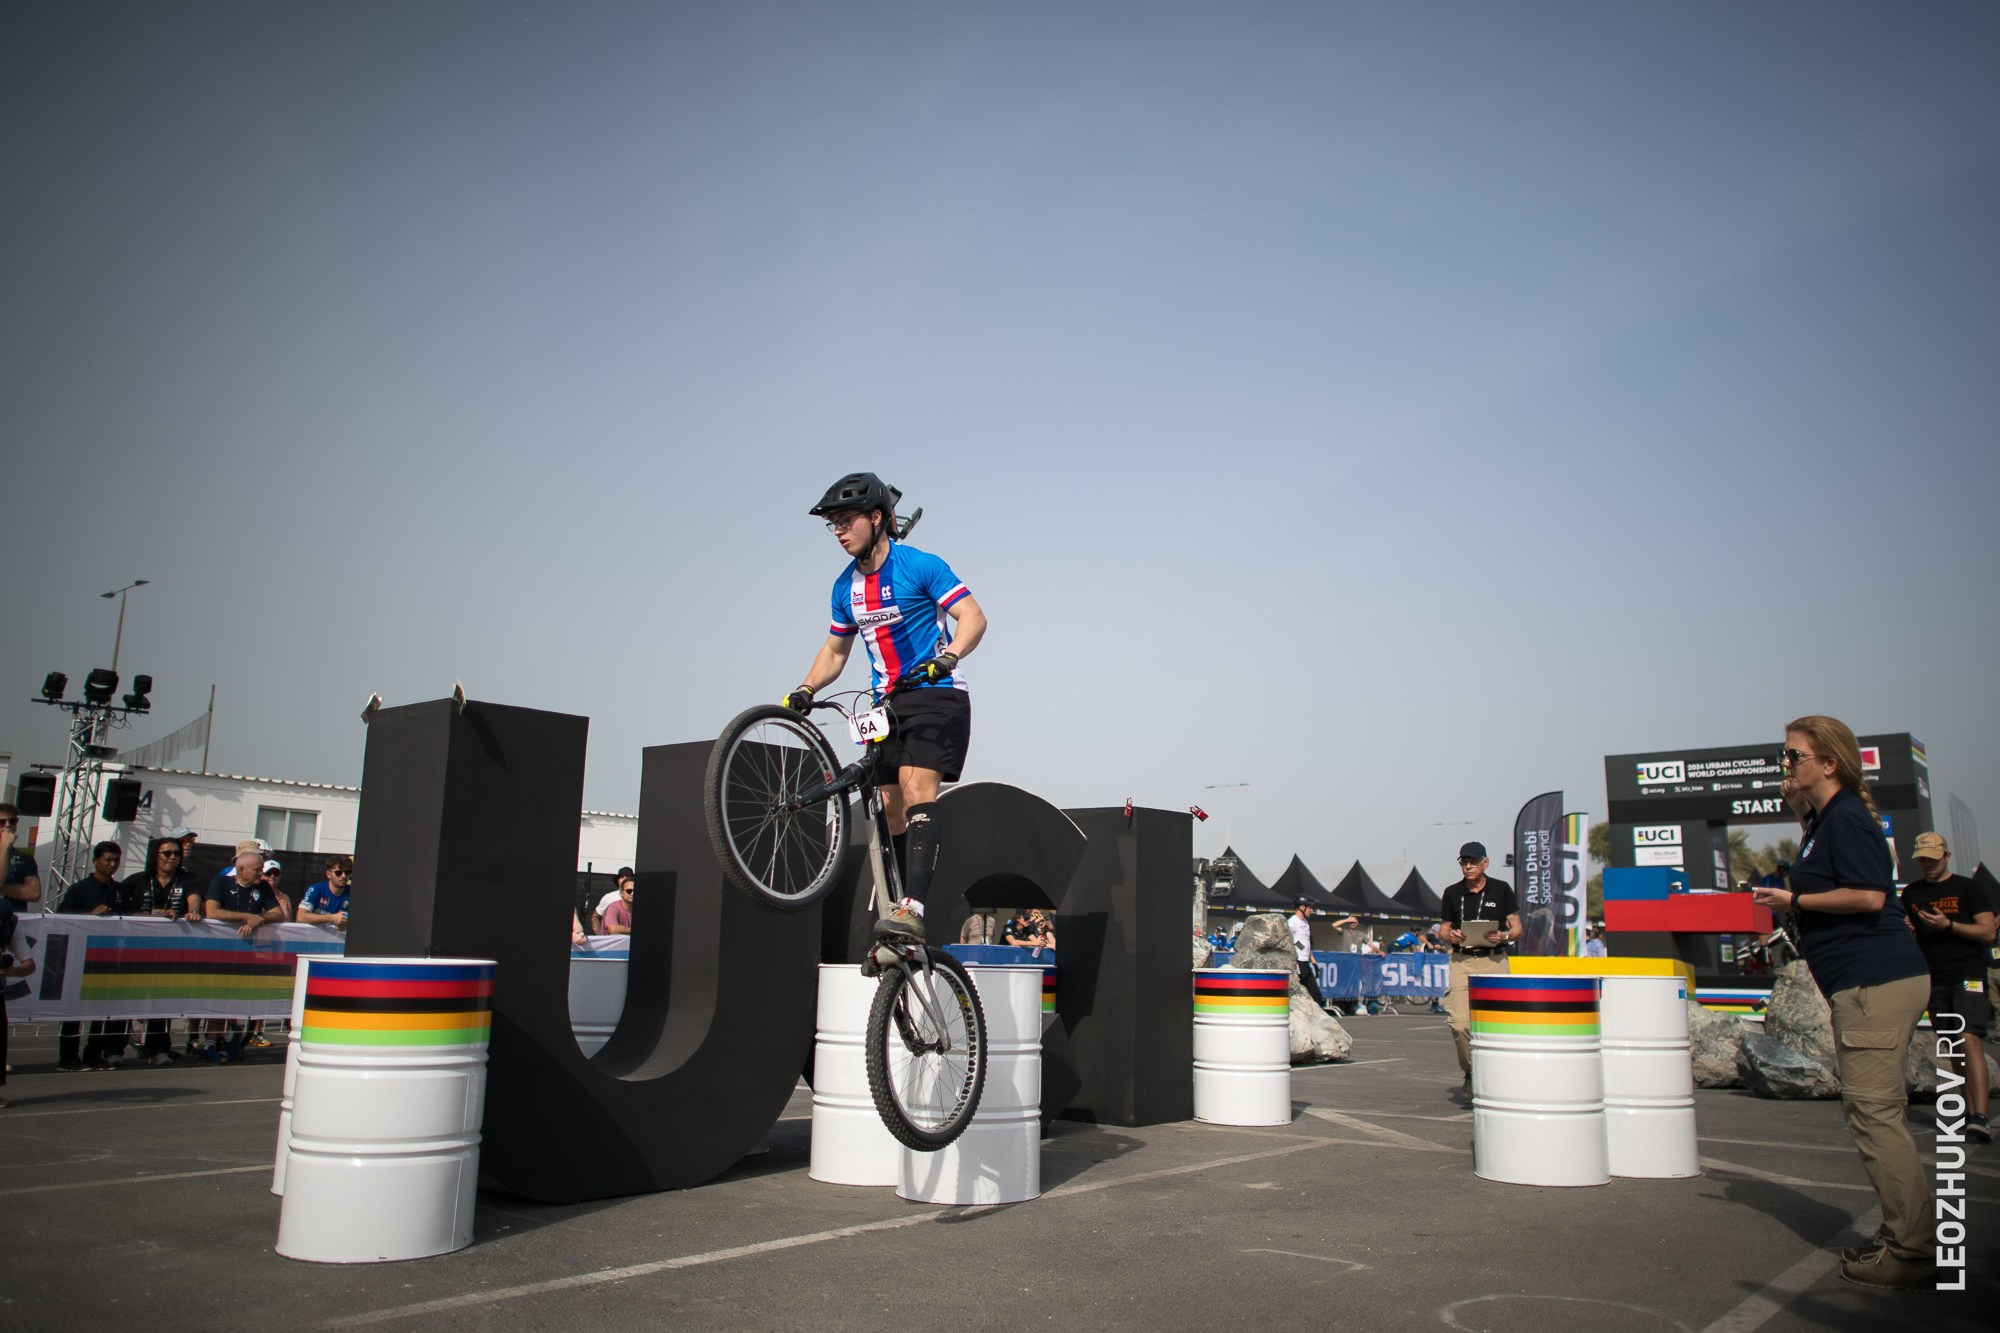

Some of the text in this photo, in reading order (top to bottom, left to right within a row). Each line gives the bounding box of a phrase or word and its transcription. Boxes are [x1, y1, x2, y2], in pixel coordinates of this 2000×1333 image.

[860, 720, 878, 735] 6A
[1645, 765, 1681, 779] UCI
[1688, 759, 1766, 771] 2024 URBAN CYCLING
[1688, 765, 1781, 778] WORLD CHAMPIONSHIPS
[1732, 799, 1783, 814] START
[1645, 829, 1675, 841] UCI
[1524, 831, 1539, 904] Abu Dhabi
[1539, 830, 1552, 905] Sports Council
